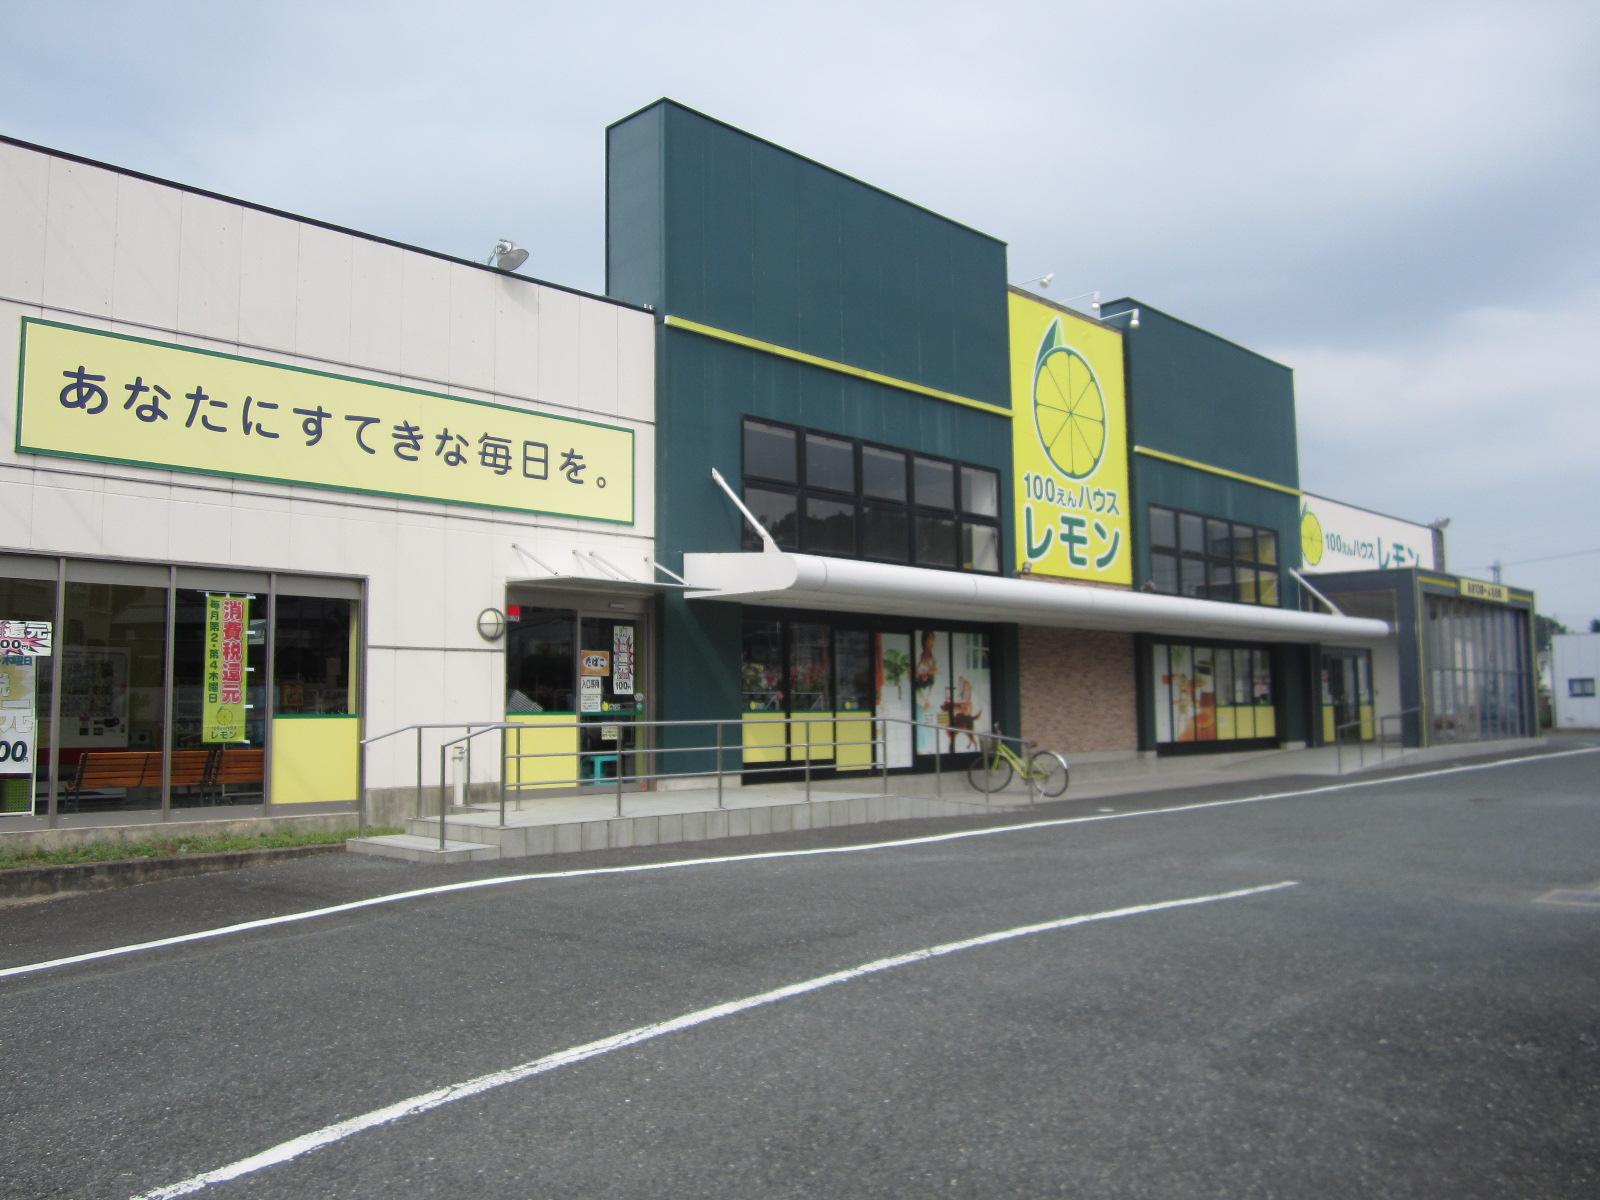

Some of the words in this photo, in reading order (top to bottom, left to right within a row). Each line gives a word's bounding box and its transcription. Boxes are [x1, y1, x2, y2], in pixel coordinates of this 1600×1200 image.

[59, 365, 608, 490] あなたにすてきな毎日を。
[1024, 472, 1120, 515] 100えんハウス
[1025, 506, 1121, 568] レモン
[1377, 536, 1420, 569] レモン
[0, 622, 48, 640] 還元
[222, 599, 243, 704] 消費税還元
[211, 730, 237, 740] レモン
